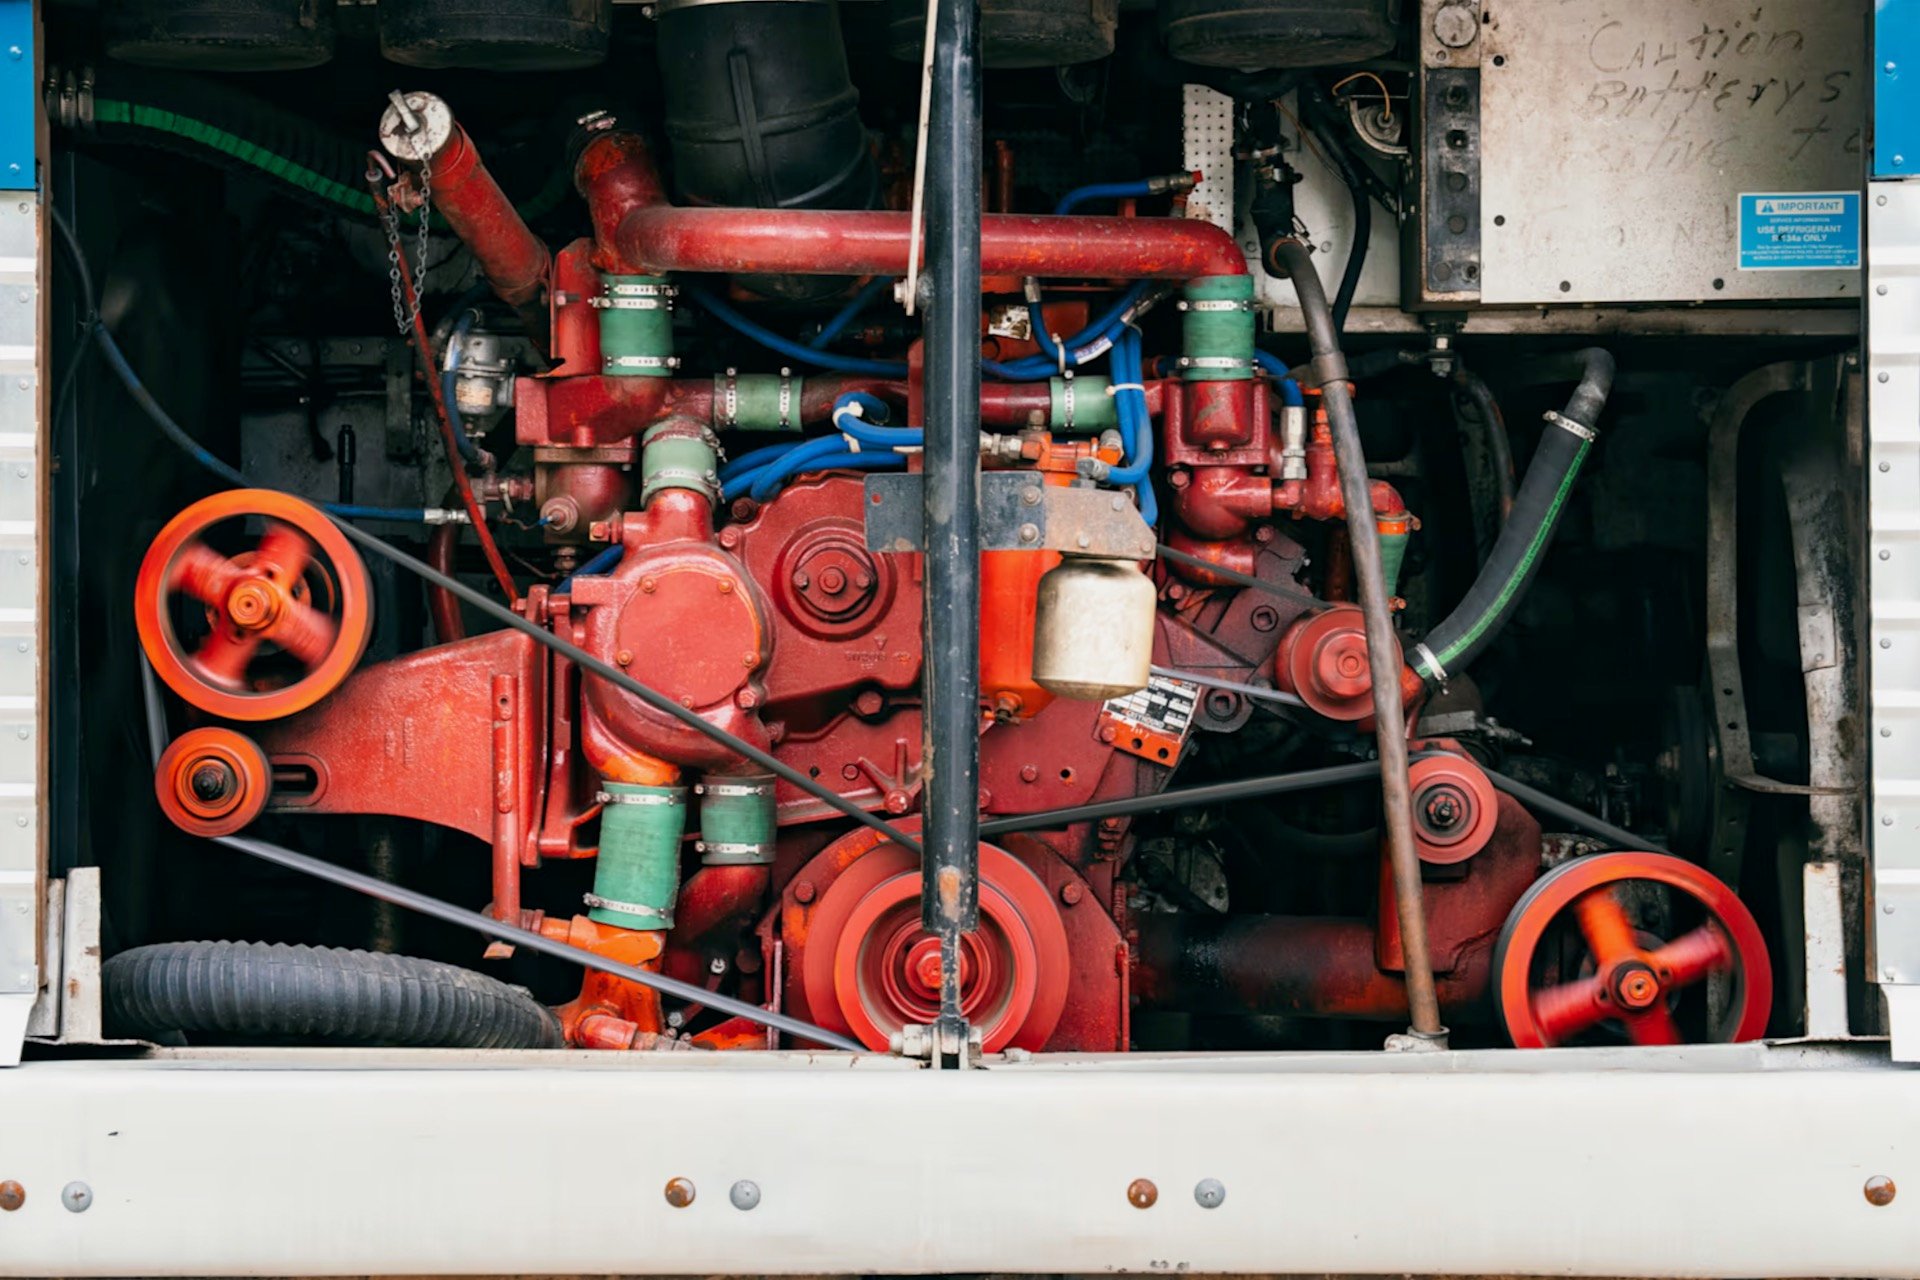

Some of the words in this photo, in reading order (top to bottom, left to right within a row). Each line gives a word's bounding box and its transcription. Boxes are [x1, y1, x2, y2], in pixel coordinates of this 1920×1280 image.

[1776, 201, 1840, 211] IMPORTANT
[1757, 225, 1776, 234] USE
[1777, 224, 1842, 234] REFRIGERANT
[1803, 233, 1828, 241] ONLY
